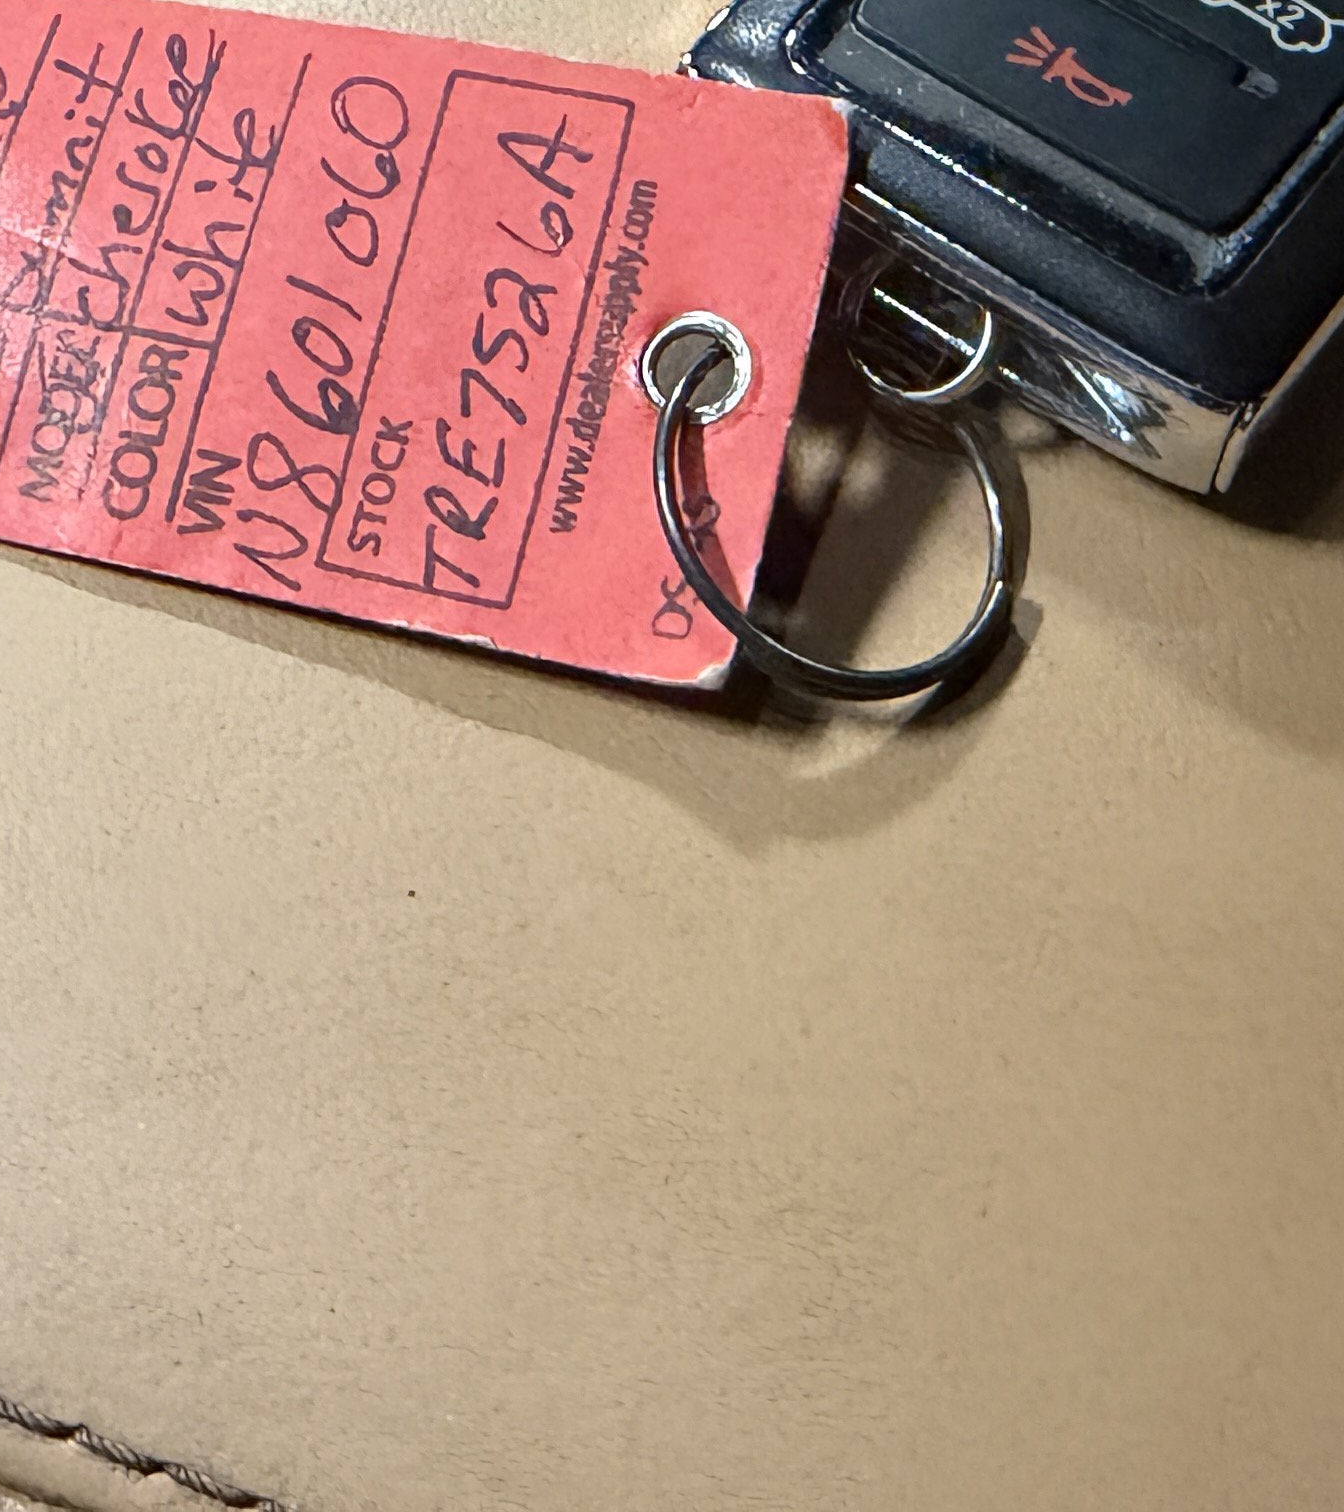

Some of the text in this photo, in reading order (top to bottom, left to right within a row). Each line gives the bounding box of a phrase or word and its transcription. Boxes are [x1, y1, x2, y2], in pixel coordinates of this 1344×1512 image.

[423, 113, 595, 590] TRE7526A
[102, 345, 190, 521] COLOR
[177, 448, 242, 536] VIN
[347, 415, 414, 558] STOCK
